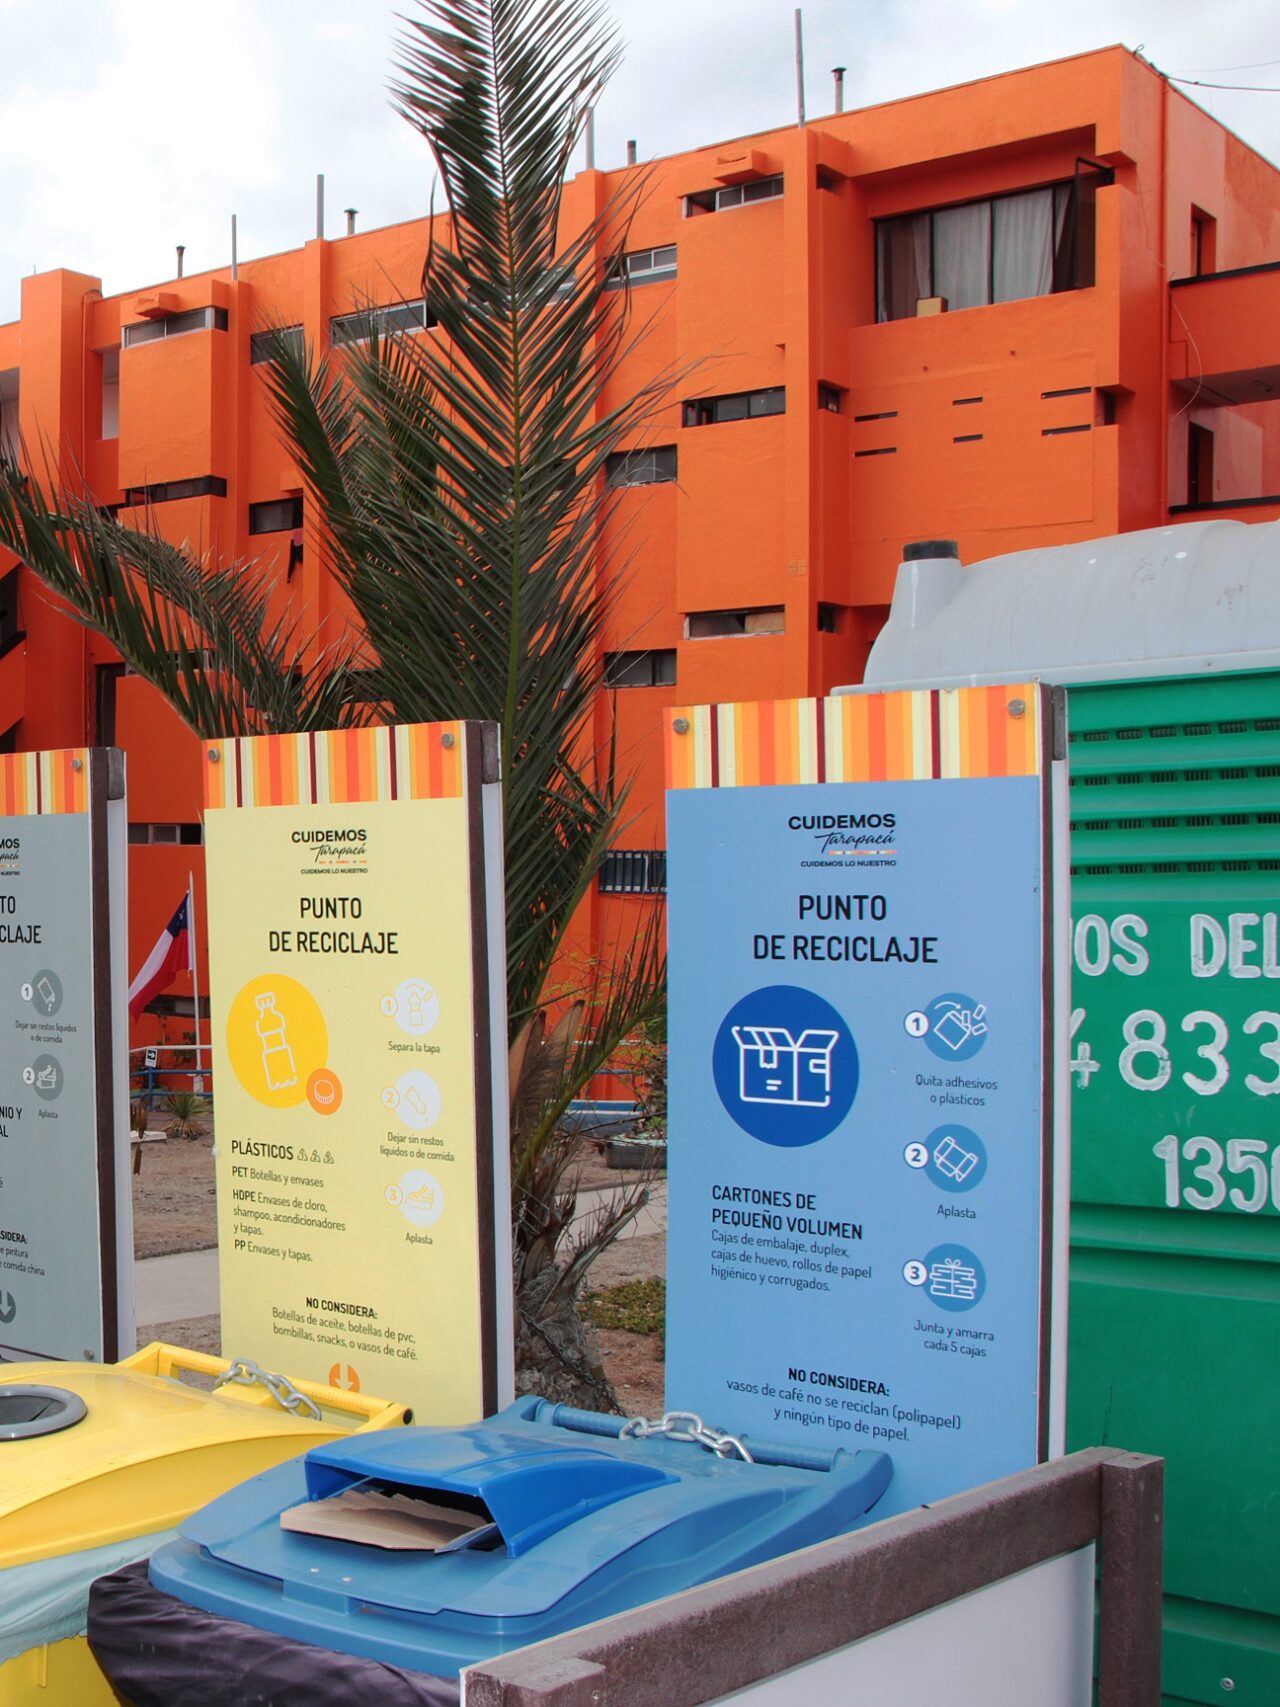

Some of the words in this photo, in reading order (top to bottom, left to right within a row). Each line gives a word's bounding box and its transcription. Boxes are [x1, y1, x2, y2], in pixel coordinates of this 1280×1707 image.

[788, 813, 896, 830] CUIDEMOS
[291, 829, 367, 843] CUIDEMOS
[814, 829, 896, 854] Tarapacá
[300, 897, 362, 919] PUNTO
[798, 895, 887, 921] PUNTO
[269, 931, 292, 952] DE
[296, 931, 399, 954] RECICLAJE
[753, 934, 785, 960] DE
[793, 935, 939, 964] RECICLAJE
[1070, 913, 1150, 977] OS
[1190, 912, 1280, 978] DEL
[912, 1017, 921, 1031] 1
[388, 1040, 414, 1053] Separa
[415, 1042, 422, 1053] la
[423, 1043, 441, 1055] tapa
[915, 1073, 943, 1087] Quita
[944, 1075, 998, 1090] adhesivos
[929, 1094, 937, 1103] o
[939, 1092, 986, 1106] plásticos
[16, 1107, 23, 1120] Y
[231, 1137, 294, 1160] PLÁSTICOS
[387, 1131, 406, 1145] Dejar
[408, 1134, 419, 1144] sin
[420, 1136, 444, 1146] restos
[409, 1150, 415, 1158] o
[415, 1148, 426, 1159] de
[426, 1151, 455, 1162] comida
[911, 1148, 921, 1162] 2
[232, 1166, 248, 1178] PET
[250, 1168, 282, 1182] Botellas
[283, 1175, 289, 1186] y
[290, 1176, 324, 1188] envases
[1153, 1135, 1280, 1212] 135
[232, 1188, 256, 1202] HDPE
[257, 1192, 291, 1208] Envases
[292, 1197, 303, 1209] de
[712, 1184, 792, 1208] CARTONES
[796, 1193, 817, 1210] DE
[273, 1213, 346, 1231] acondicionadores
[936, 1204, 976, 1219] Aplasta
[233, 1223, 239, 1234] y
[712, 1208, 782, 1231] PEQUEÑO
[786, 1216, 863, 1240] VOLUMEN
[405, 1232, 433, 1245] Aplasta
[711, 1229, 739, 1245] Cajas
[741, 1233, 754, 1245] de
[5, 1247, 29, 1259] pintura
[234, 1239, 246, 1250] PP
[247, 1241, 280, 1256] Envases
[282, 1249, 287, 1260] y
[3, 1261, 26, 1273] comida
[27, 1264, 45, 1276] china
[711, 1250, 737, 1262] cajas
[739, 1250, 753, 1263] de
[755, 1253, 790, 1269] huevo,
[792, 1257, 822, 1272] rollos
[824, 1262, 839, 1274] de
[841, 1266, 872, 1280] papel
[910, 1266, 920, 1280] 3
[711, 1264, 757, 1282] higiénico
[758, 1273, 766, 1286] y
[768, 1274, 831, 1292] corrugados.
[306, 1297, 319, 1309] NO
[321, 1299, 378, 1320] CONSIDERA:
[272, 1306, 305, 1324] Botellas
[306, 1313, 318, 1326] de
[348, 1321, 383, 1338] botellas
[384, 1328, 396, 1340] de
[913, 1320, 945, 1334] Junta
[946, 1326, 953, 1338] y
[955, 1327, 995, 1342] amarra
[349, 1340, 355, 1349] o
[357, 1341, 381, 1354] vasos
[383, 1344, 395, 1356] de
[924, 1340, 948, 1352] cada
[950, 1341, 957, 1353] 5
[959, 1344, 987, 1359] cajas
[788, 1367, 806, 1383] NO
[809, 1371, 890, 1397] CONSIDERA:
[726, 1379, 759, 1394] vasos
[761, 1383, 776, 1397] de
[778, 1386, 804, 1402] café
[806, 1393, 822, 1405] no
[824, 1396, 839, 1408] se
[841, 1399, 889, 1418] reciclan
[892, 1404, 961, 1430] (polipapel)
[773, 1406, 782, 1421] y
[784, 1407, 825, 1427] ningún
[828, 1415, 851, 1431] tipo
[854, 1419, 870, 1434] de
[872, 1425, 911, 1442] papel.
